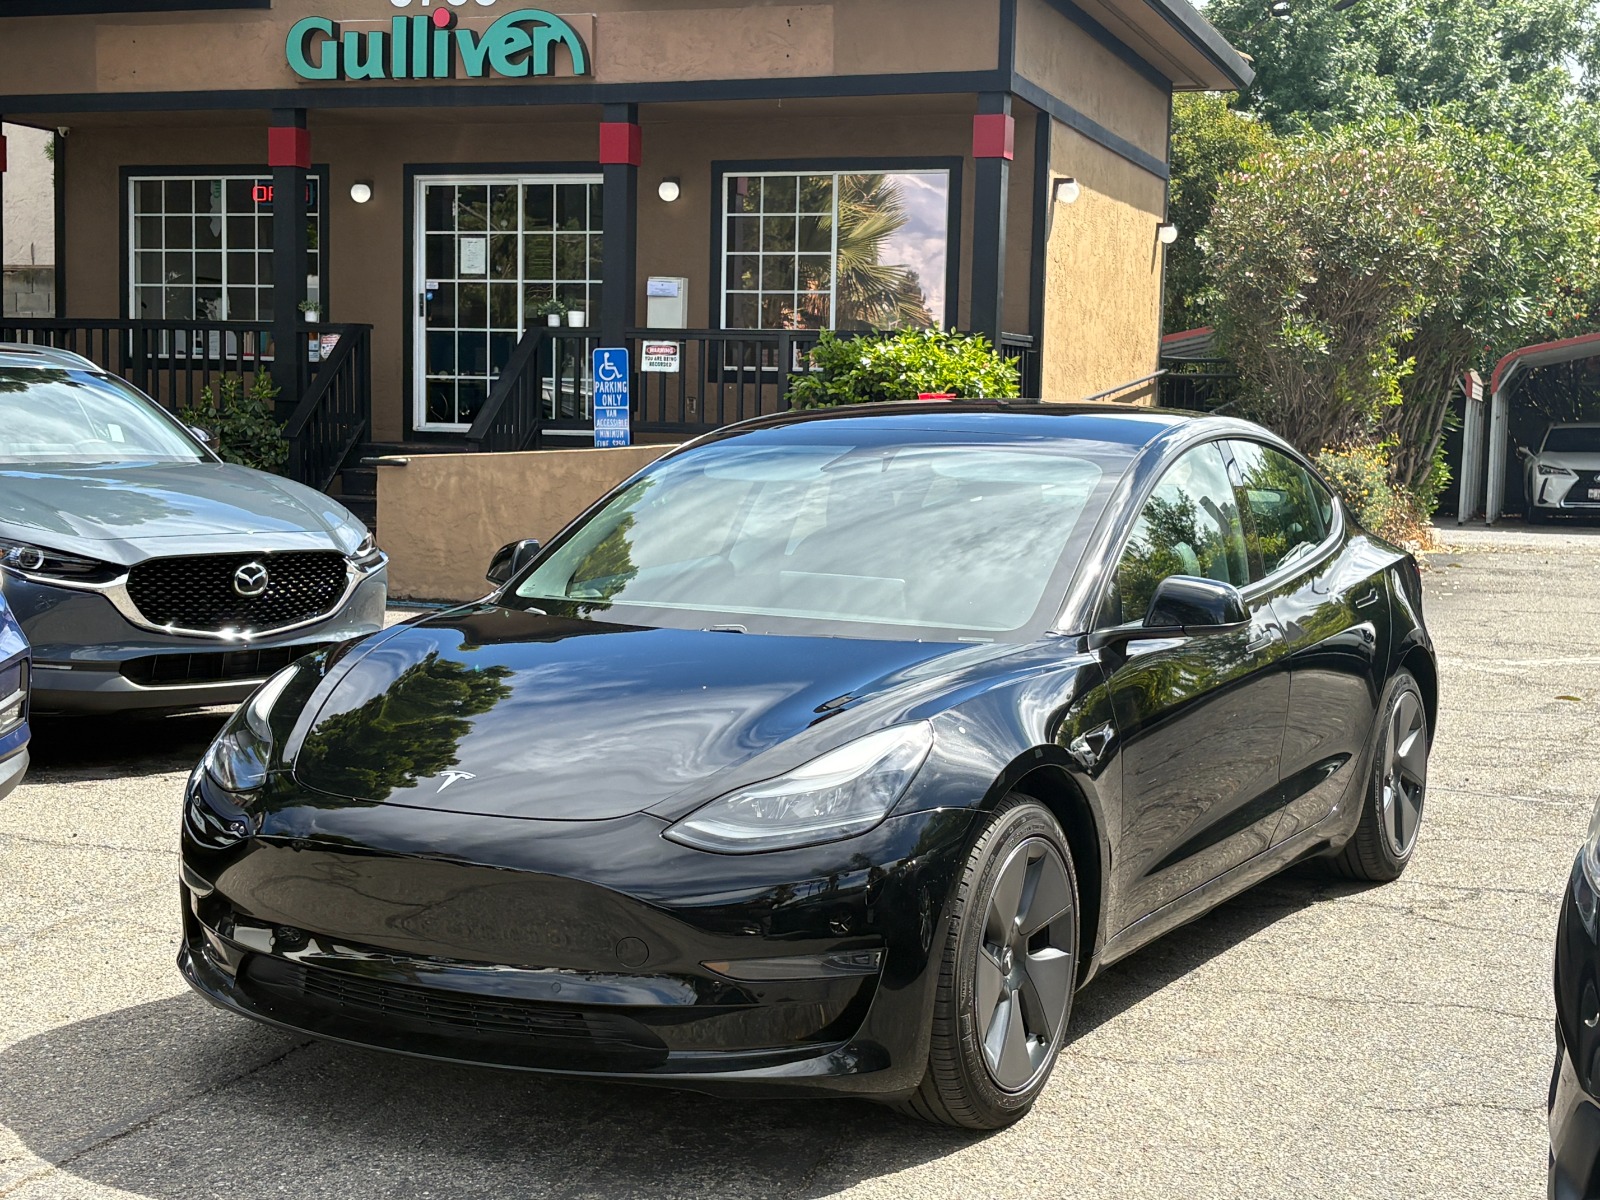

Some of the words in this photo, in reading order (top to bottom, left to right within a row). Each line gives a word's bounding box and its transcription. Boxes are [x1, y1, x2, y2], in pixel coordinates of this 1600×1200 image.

[286, 7, 586, 80] Gulliver
[595, 381, 627, 393] PARKING
[602, 394, 622, 406] ONLY
[596, 419, 627, 427] ACCESSIBLE
[600, 430, 624, 438] MINIMUM
